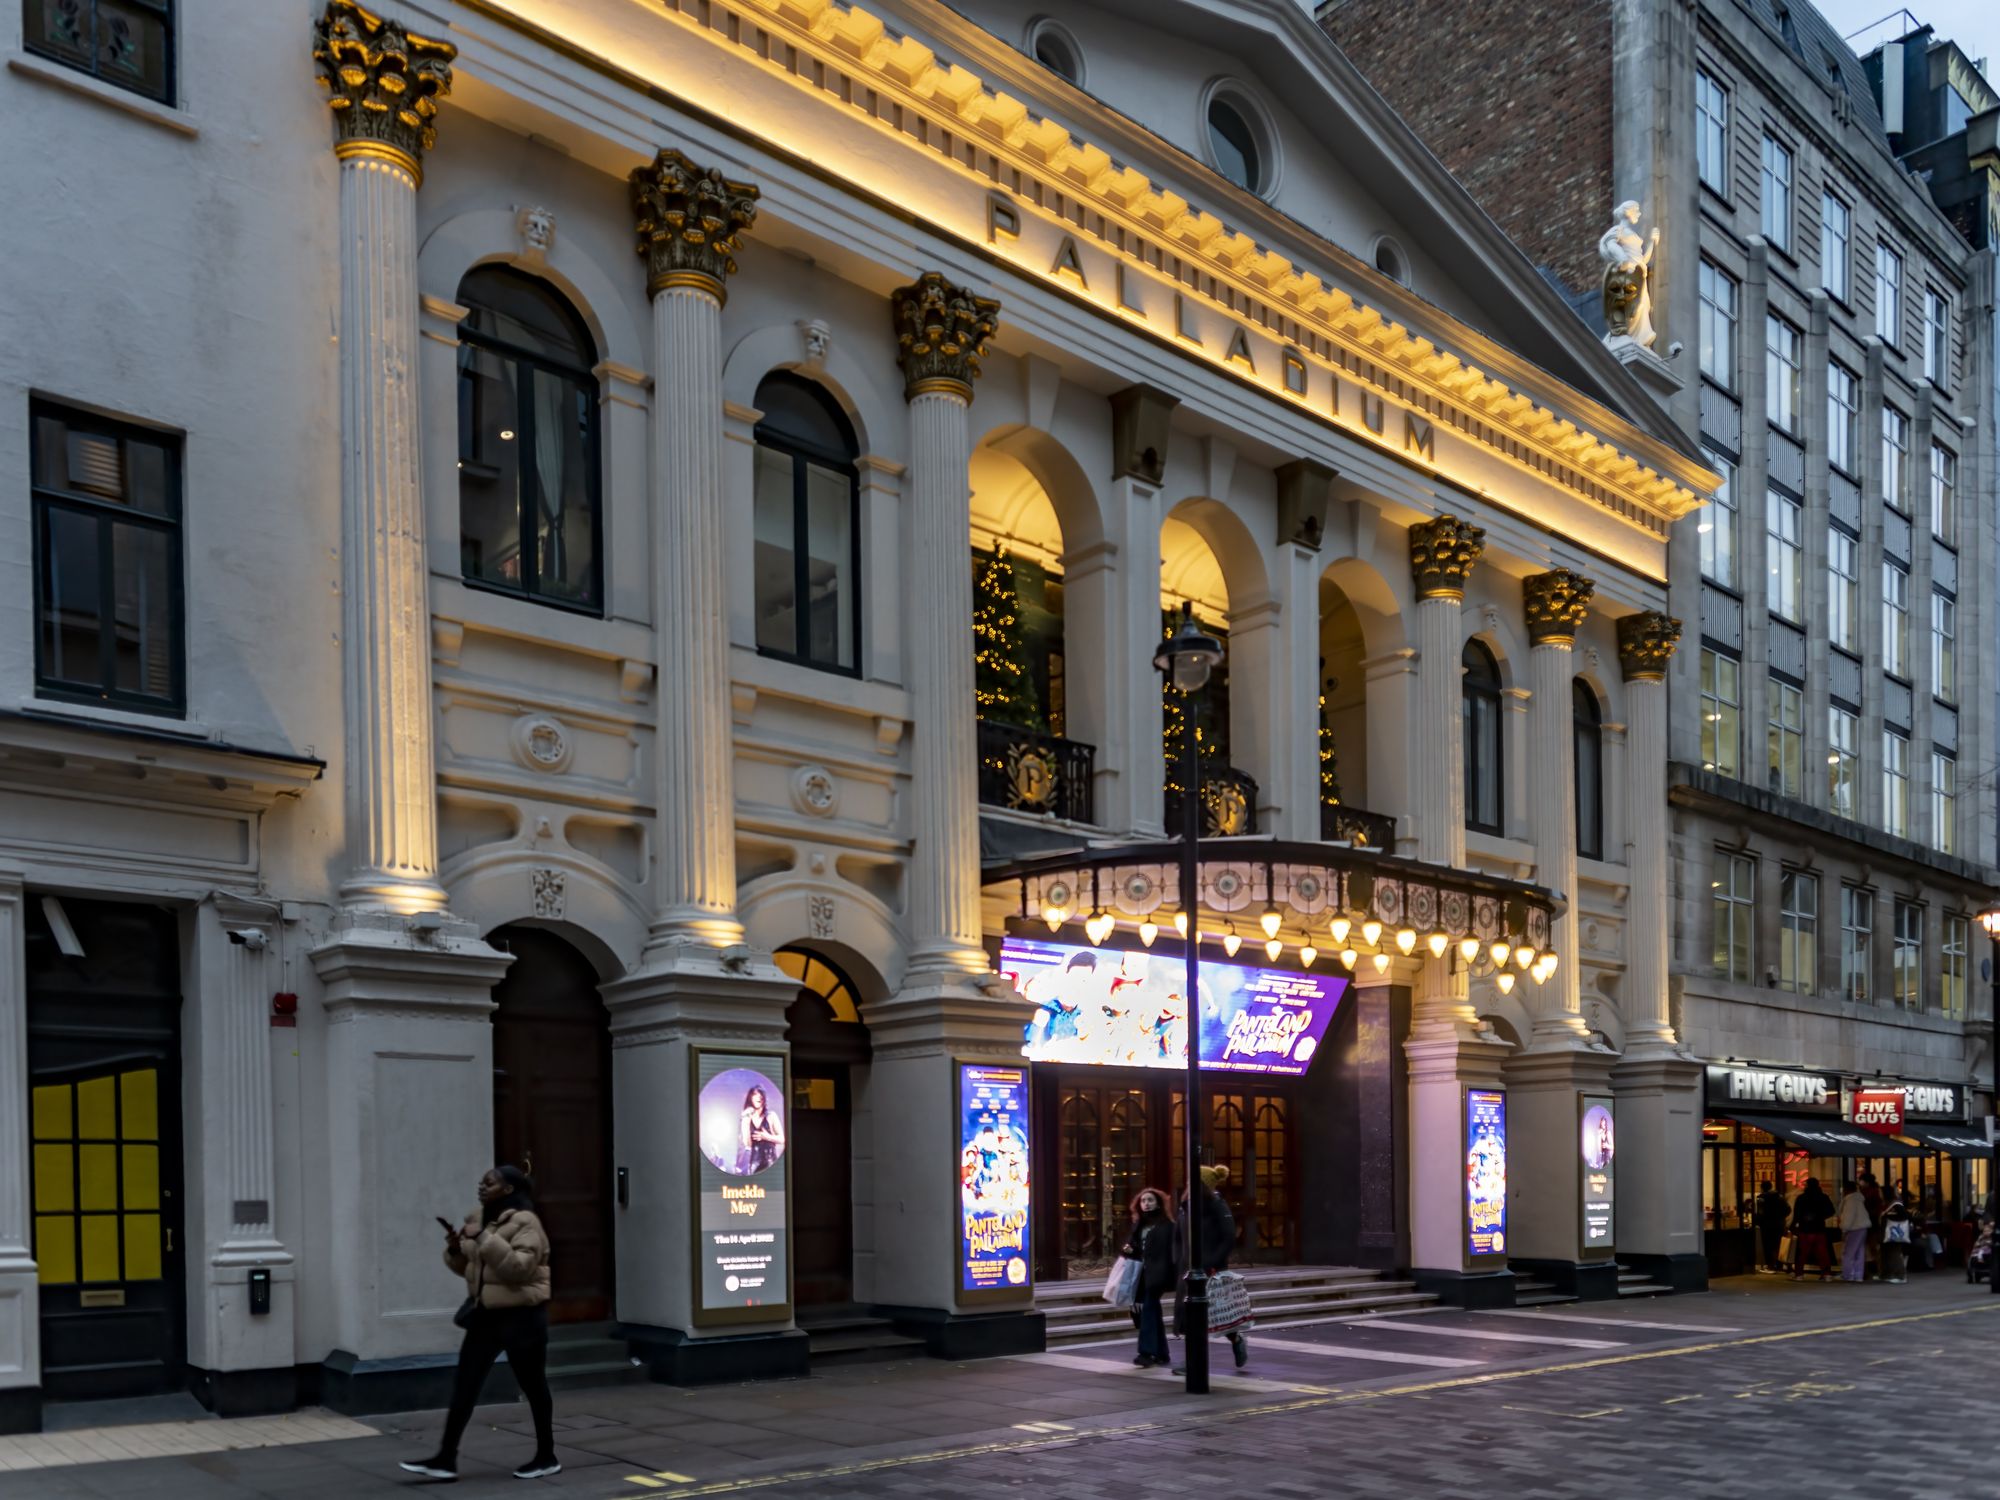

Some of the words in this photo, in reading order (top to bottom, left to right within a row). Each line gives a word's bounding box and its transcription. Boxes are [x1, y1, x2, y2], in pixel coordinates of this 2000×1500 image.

[985, 190, 1436, 464] PALLADIUM
[1226, 1009, 1313, 1038] PANTOLAND
[1223, 1032, 1299, 1060] PALLADIUM
[1731, 1071, 1776, 1101] FIVE
[1776, 1074, 1827, 1104] GUYS
[1914, 1086, 1954, 1113] GUYS
[1854, 1113, 1900, 1124] GUYS
[1859, 1102, 1896, 1113] FIVE
[722, 1184, 766, 1199] Imelda
[730, 1200, 757, 1217] May
[965, 1209, 1027, 1239] PANTOLAND
[970, 1228, 1022, 1258] PALLADIUM
